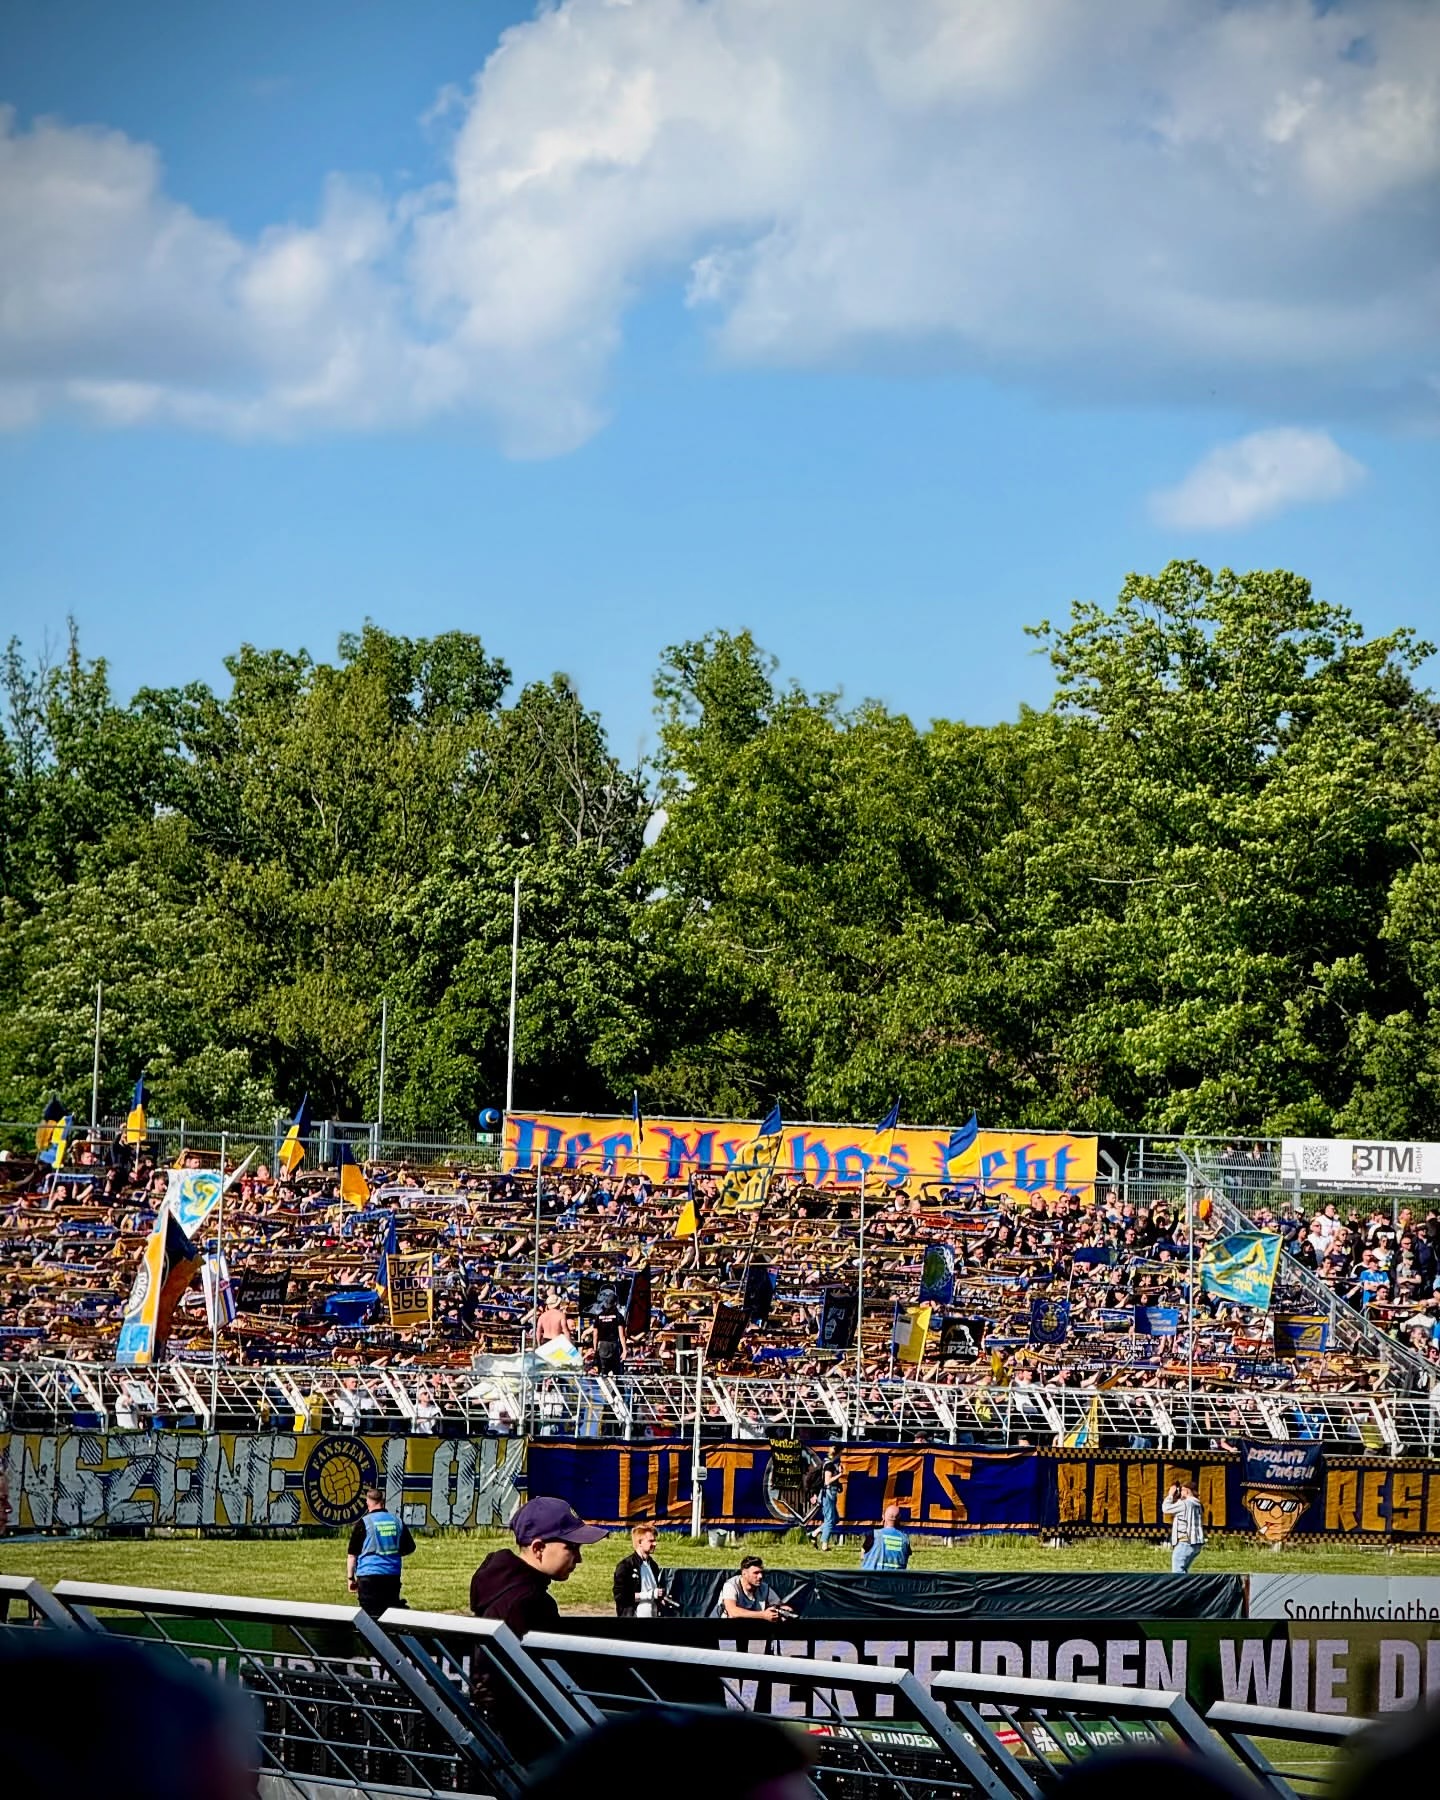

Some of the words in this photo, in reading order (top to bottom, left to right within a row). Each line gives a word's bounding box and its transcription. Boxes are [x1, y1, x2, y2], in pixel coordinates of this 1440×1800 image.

[508, 1115, 634, 1175] Der
[1352, 1145, 1413, 1173] BTM
[311, 1441, 371, 1472] FANSZENE
[381, 1436, 526, 1526] LOK
[1219, 1638, 1350, 1713] WIE
